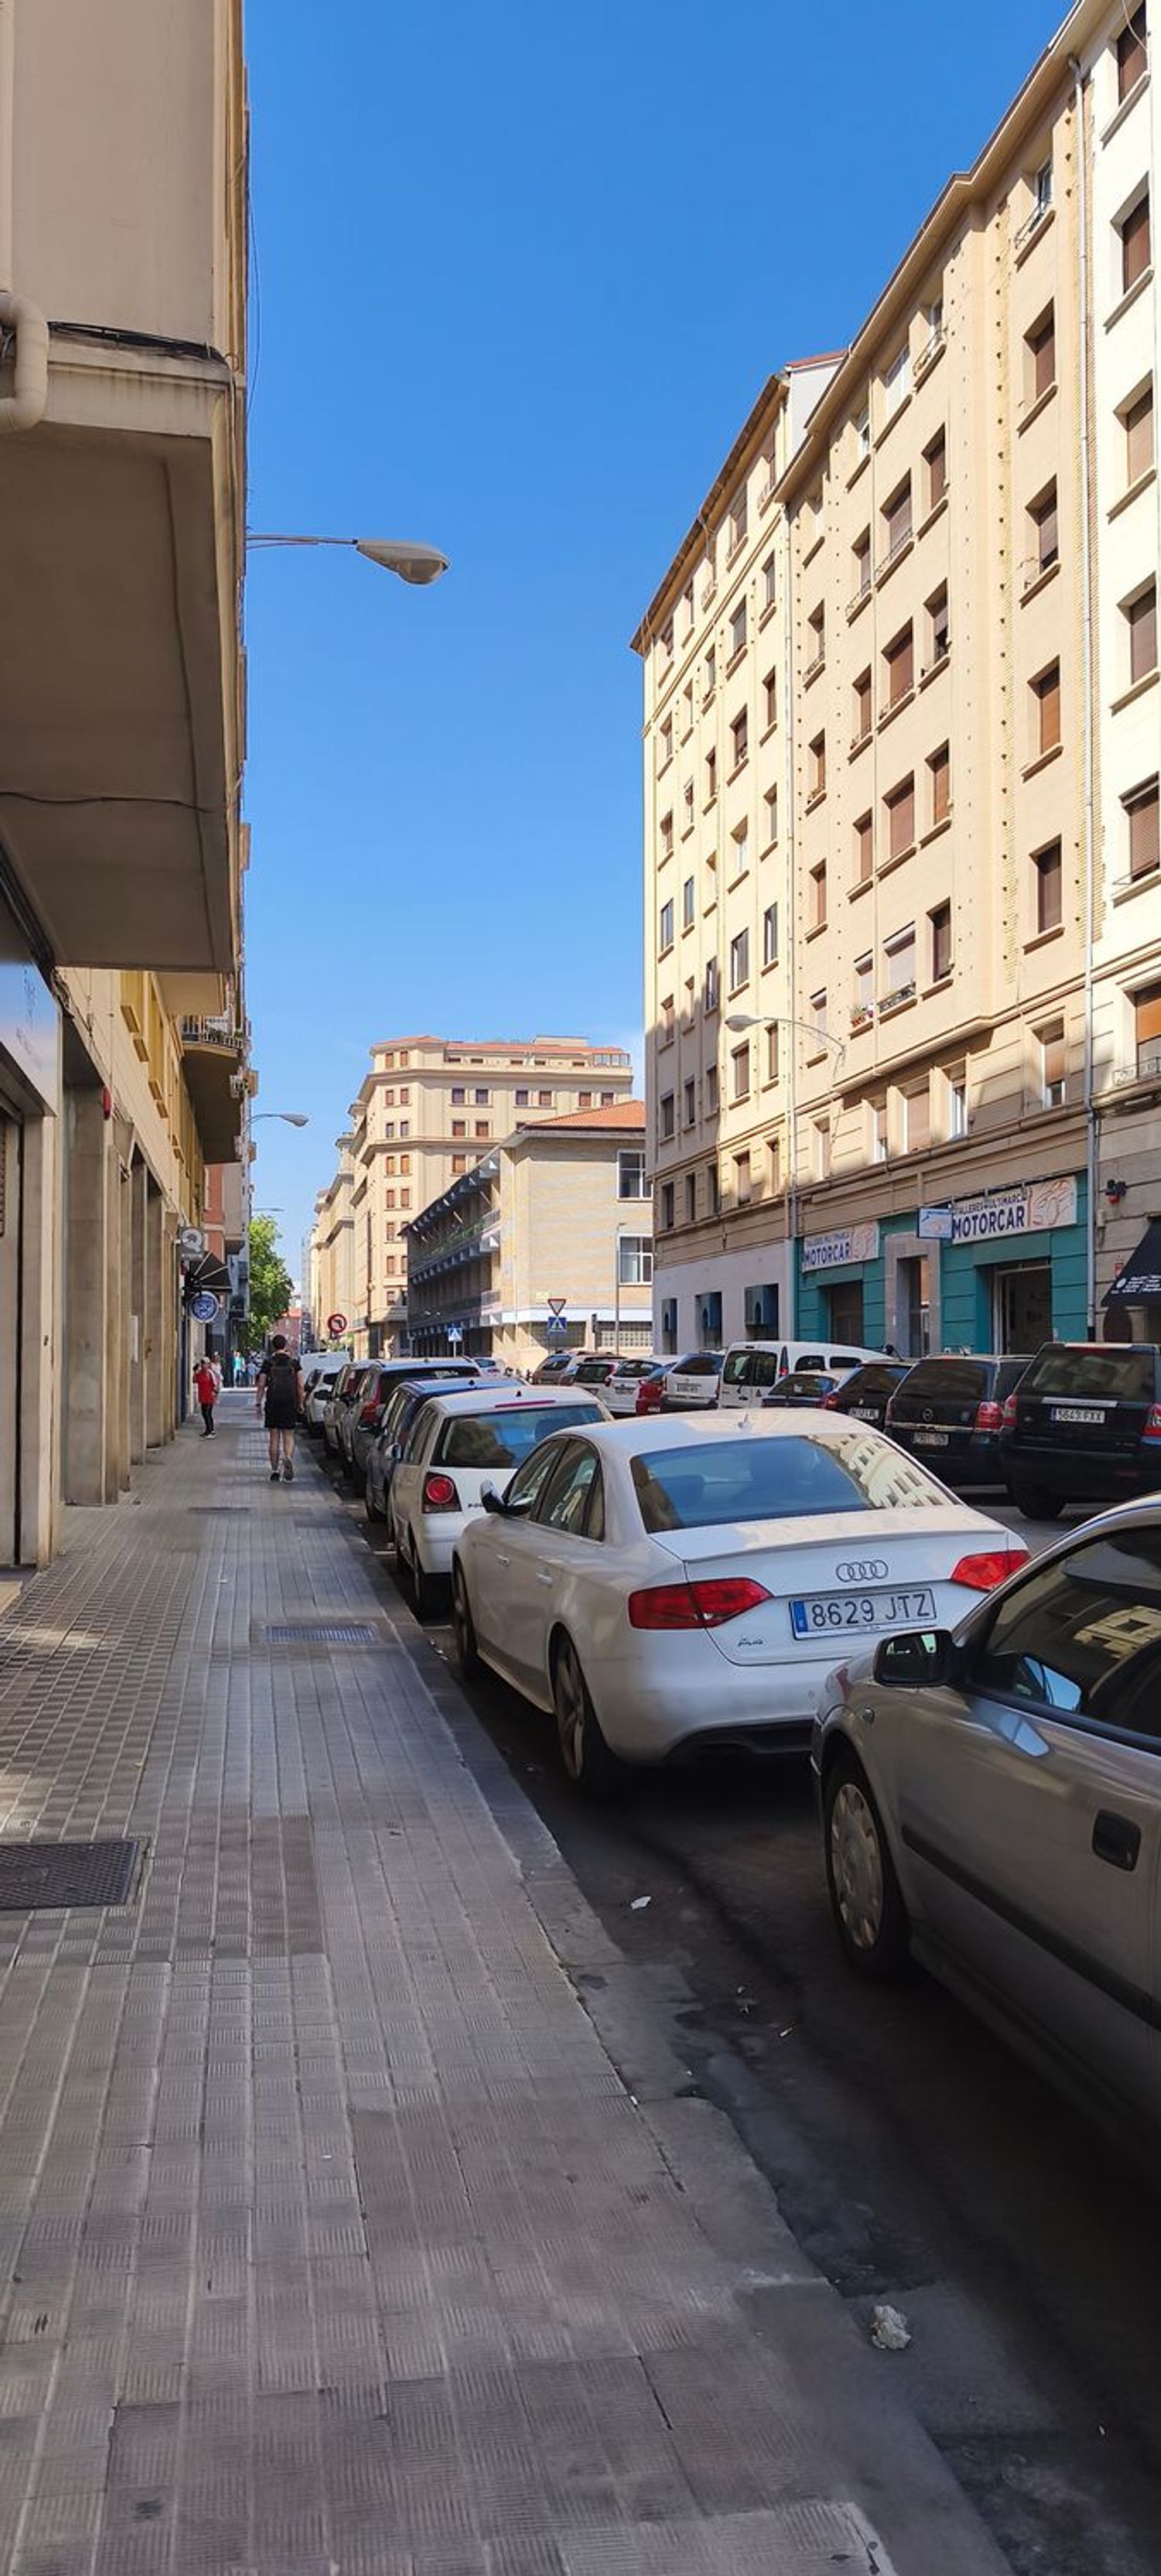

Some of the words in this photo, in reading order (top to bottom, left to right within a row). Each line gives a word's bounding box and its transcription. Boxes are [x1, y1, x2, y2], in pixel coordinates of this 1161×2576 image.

[953, 1205, 1025, 1238] MOTORCAR
[803, 1242, 851, 1266] MOTORCAR
[813, 1599, 875, 1627] 8629
[885, 1594, 930, 1621] JTZ
